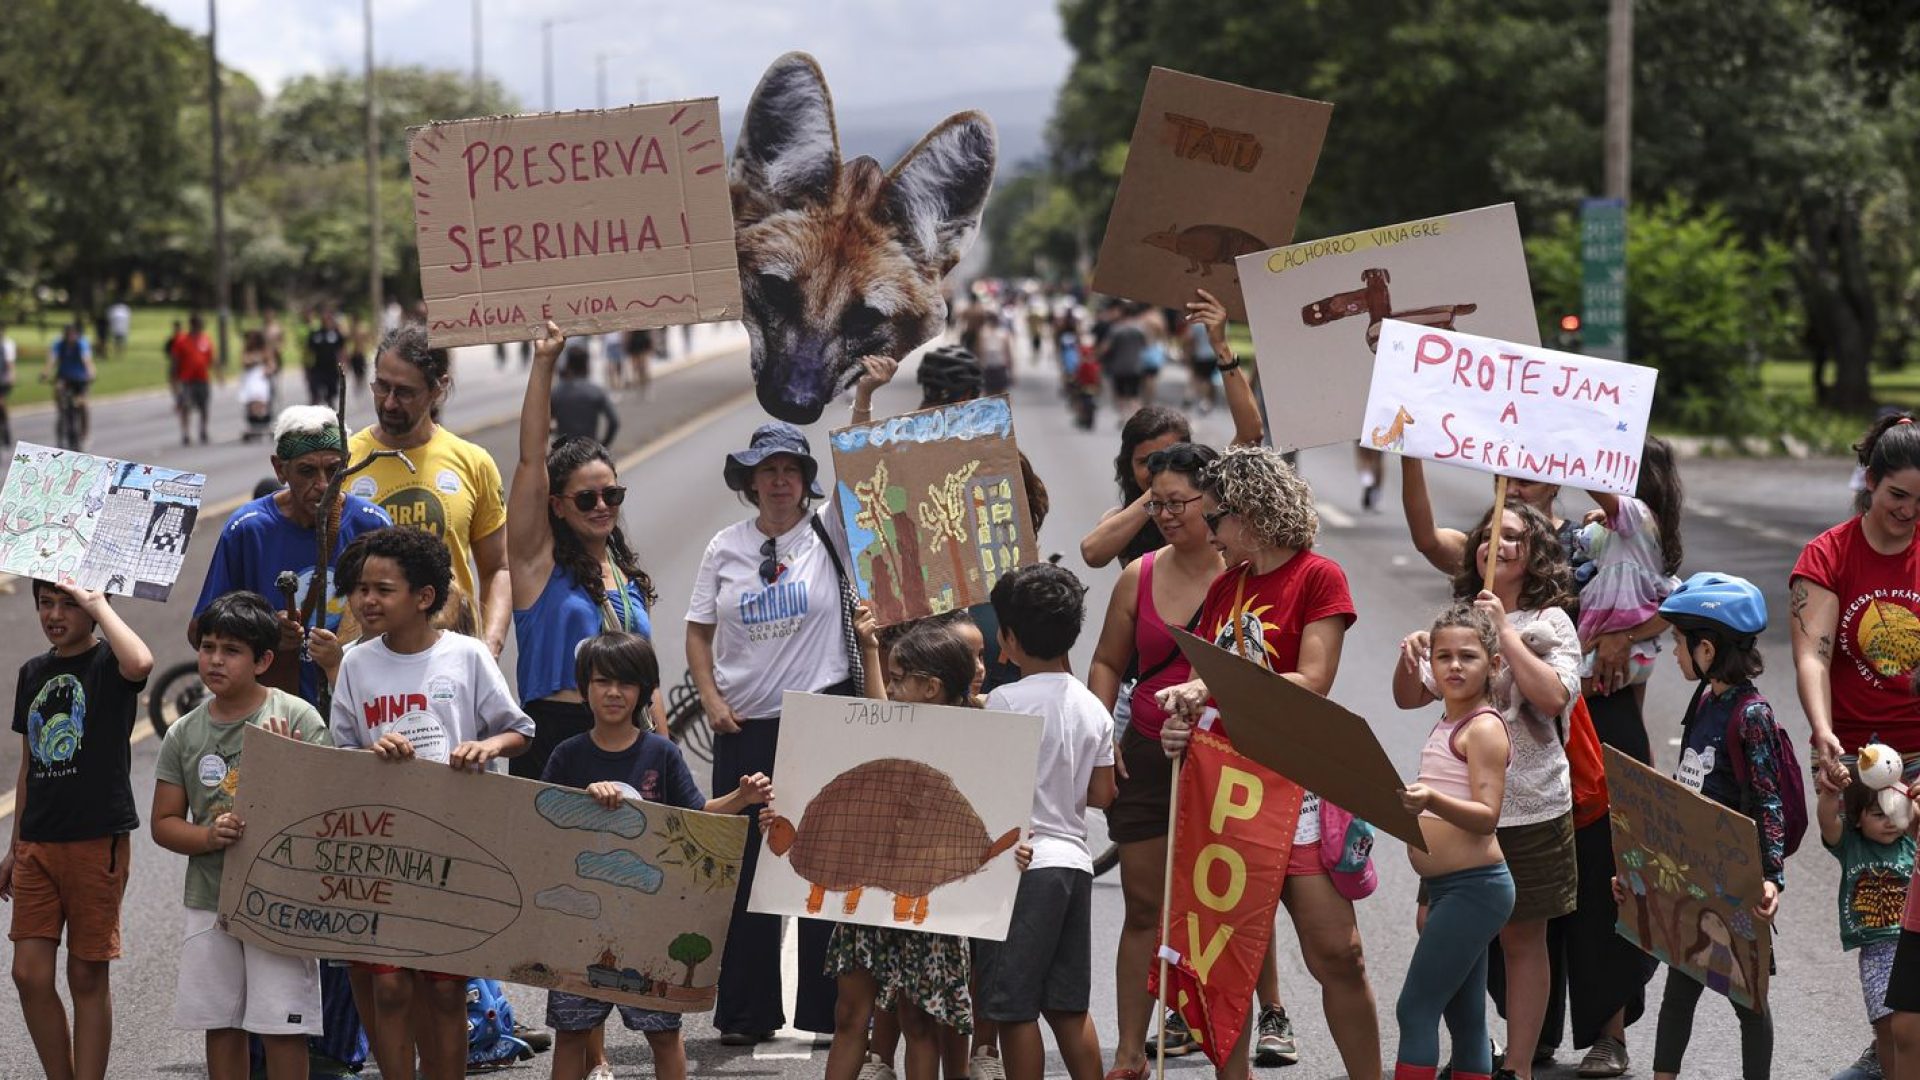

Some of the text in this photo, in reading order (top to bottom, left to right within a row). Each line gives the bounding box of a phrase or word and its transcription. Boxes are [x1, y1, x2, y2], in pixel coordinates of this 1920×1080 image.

[462, 134, 668, 200] PRESERVA
[1267, 222, 1441, 274] CACHORRO VINAGRE
[468, 301, 526, 327] ÁGUA
[542, 294, 553, 319] É
[1499, 400, 1519, 425] A
[740, 580, 809, 625] CERRADO
[1841, 592, 1875, 629] PRECISA
[1874, 588, 1888, 598] DA
[844, 702, 915, 726] JABUTI
[316, 811, 397, 838] SALVE
[270, 836, 452, 888] A SERRINHA!
[317, 875, 394, 905] SALVE
